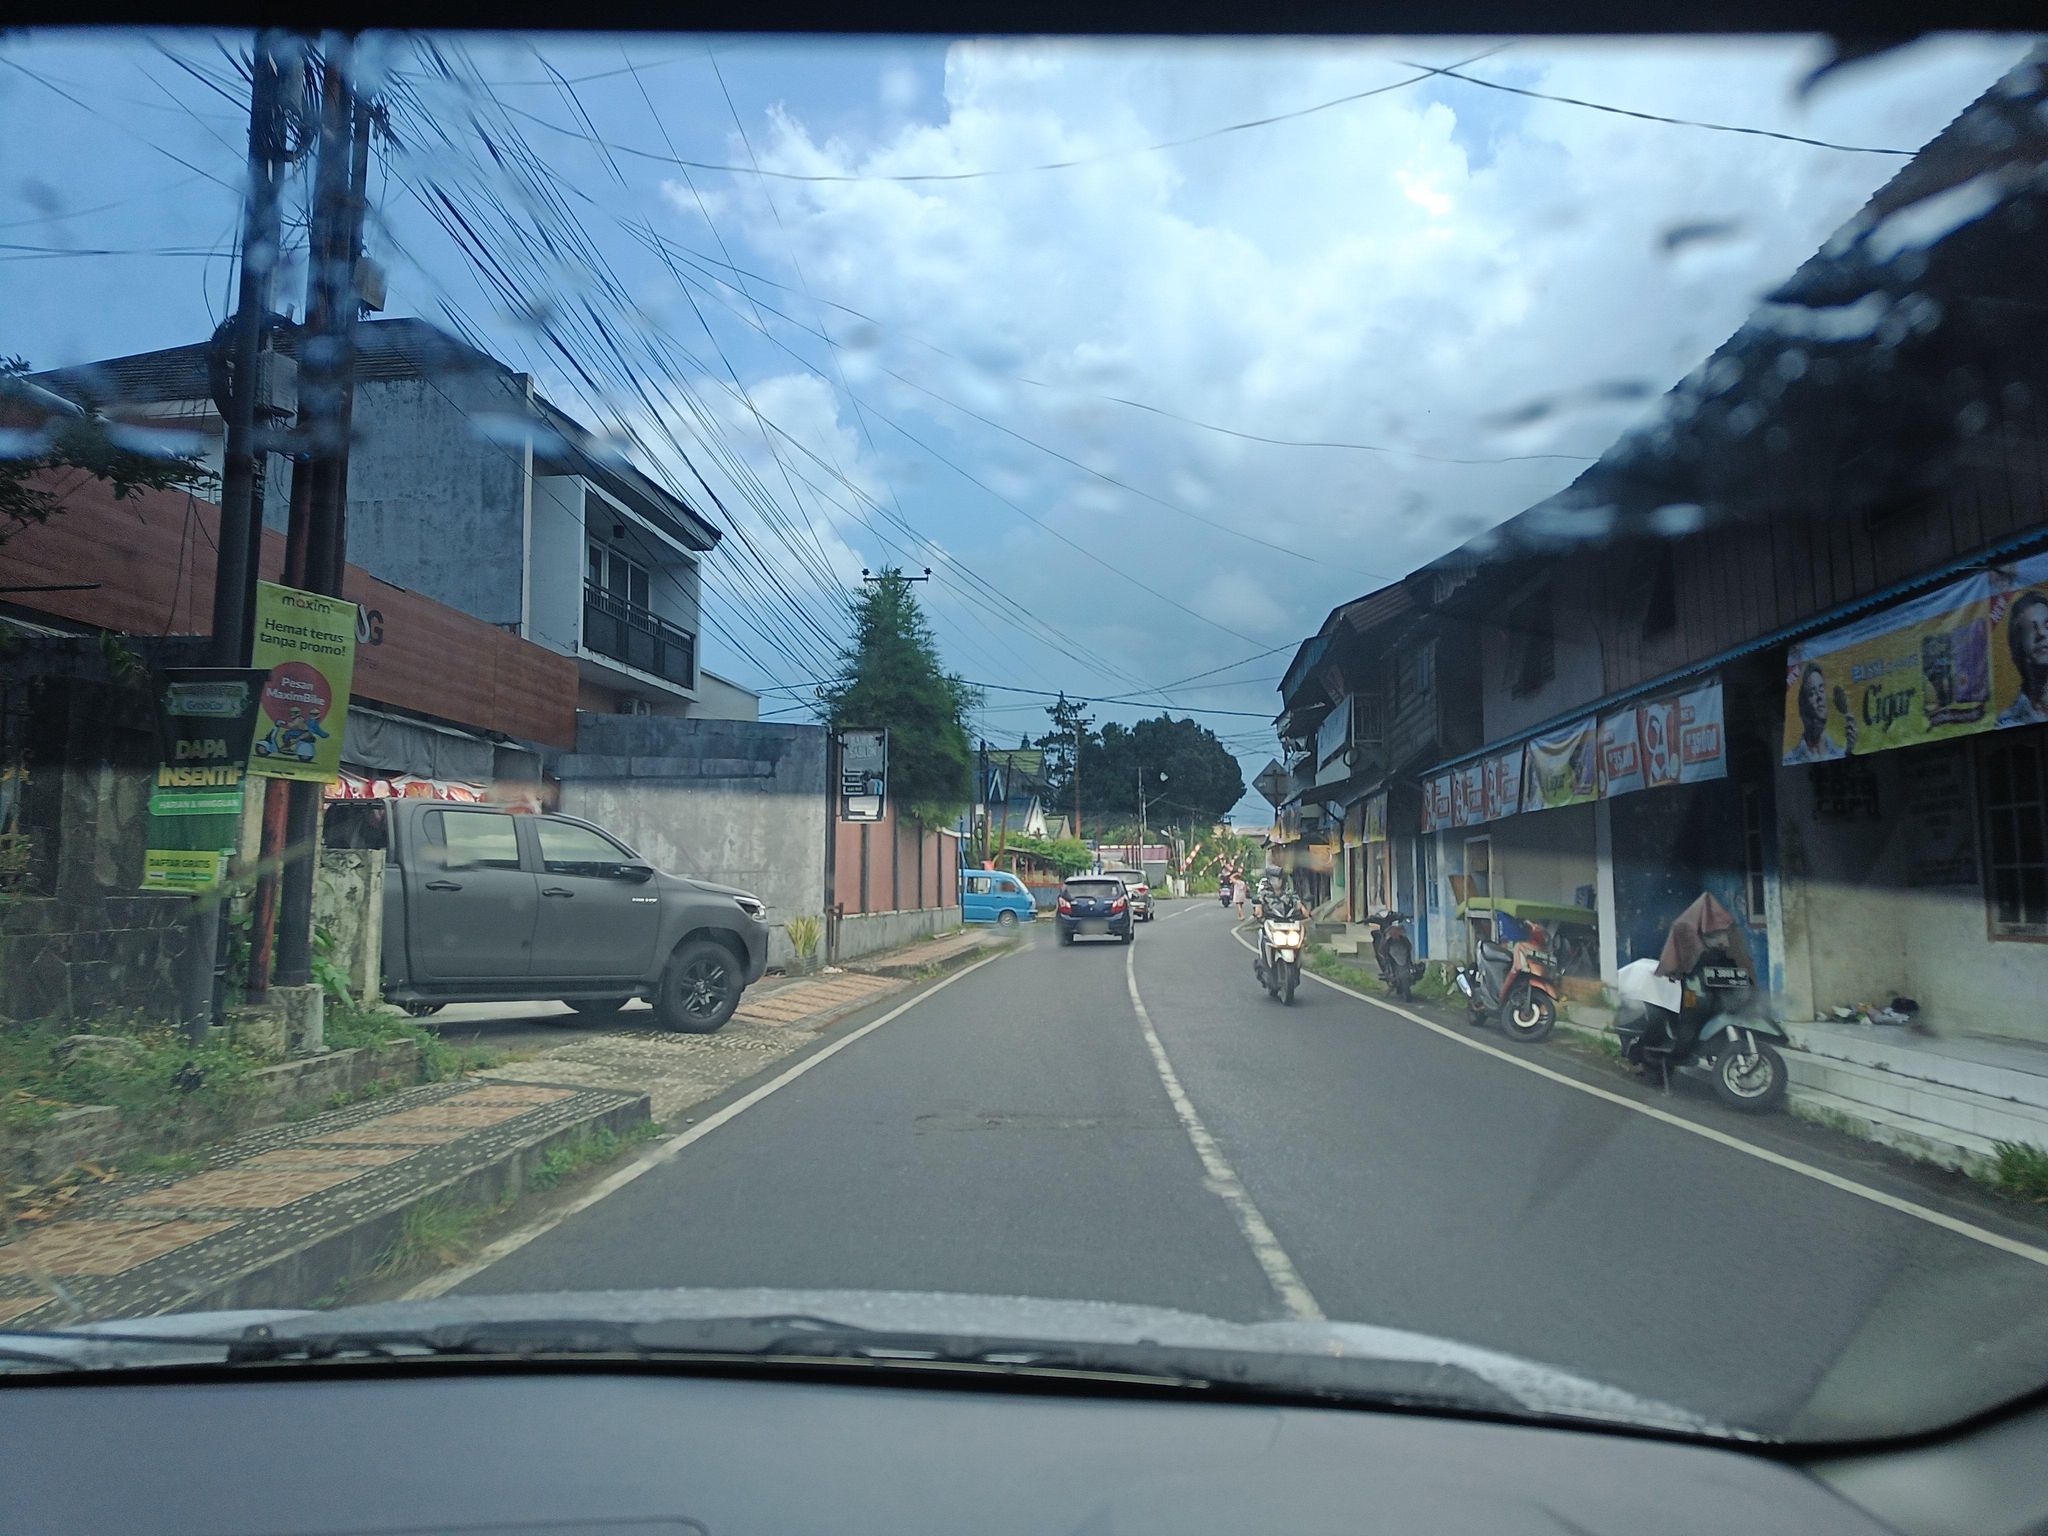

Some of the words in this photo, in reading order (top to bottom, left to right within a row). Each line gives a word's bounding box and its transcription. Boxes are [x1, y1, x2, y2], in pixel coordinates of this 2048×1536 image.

[281, 594, 332, 614] maxim
[265, 618, 308, 637] Hemat
[310, 630, 344, 643] terus
[260, 632, 296, 651] tanpa
[300, 641, 346, 656] promo!
[281, 677, 314, 690] Pesan
[267, 688, 325, 706] MaximBike
[158, 763, 245, 786] INSENTIF
